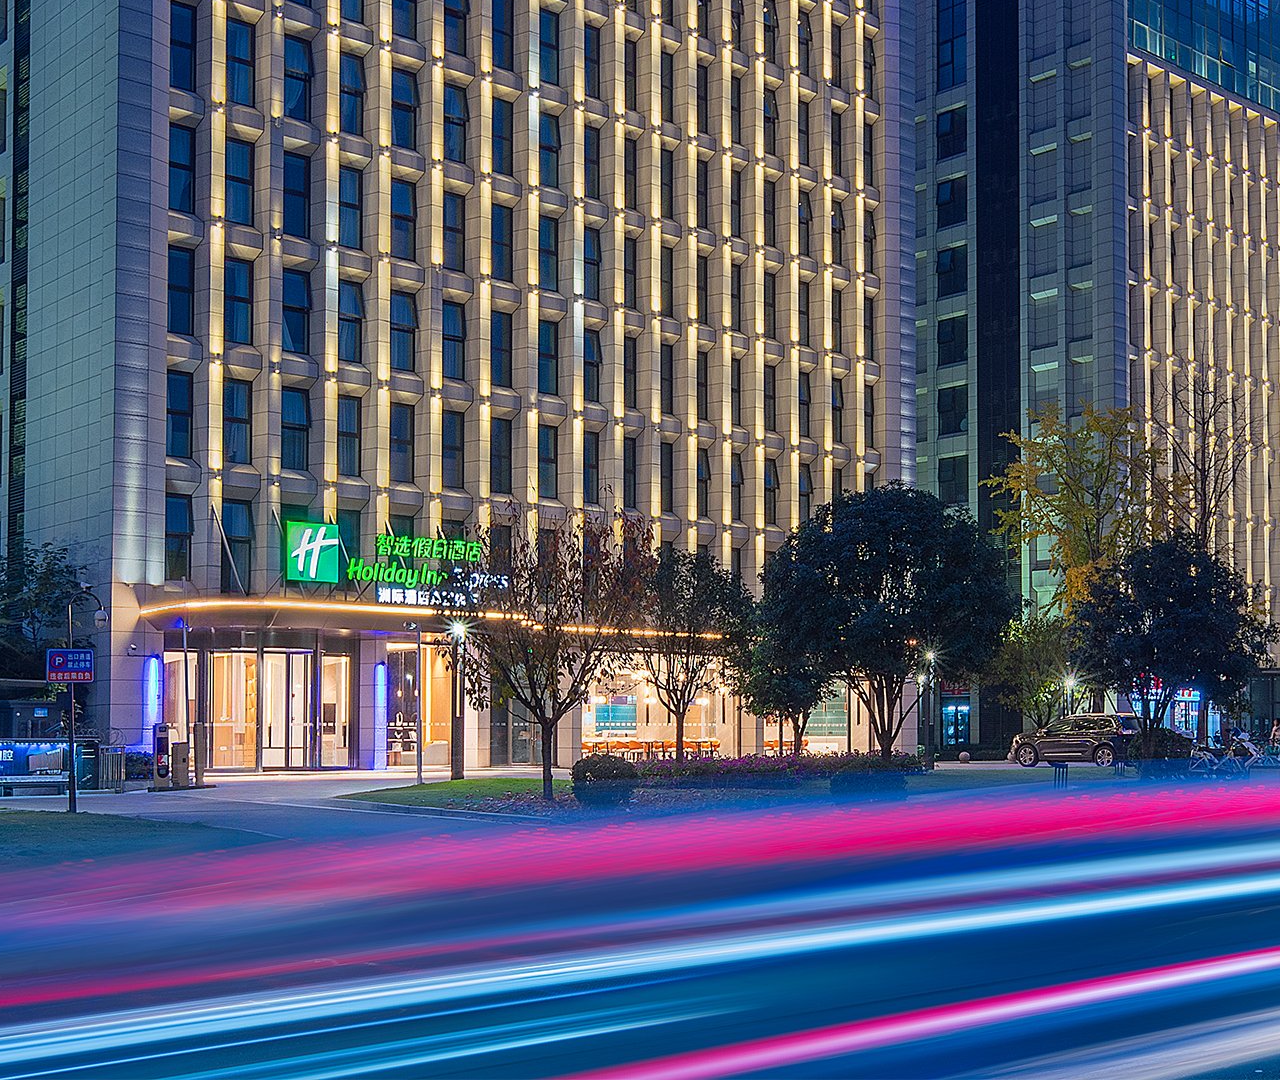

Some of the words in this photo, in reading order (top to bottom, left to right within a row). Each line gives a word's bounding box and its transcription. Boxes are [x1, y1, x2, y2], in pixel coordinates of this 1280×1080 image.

[376, 533, 482, 562] 智选假日酒店
[347, 557, 418, 588] Holiday
[453, 566, 509, 592] pres
